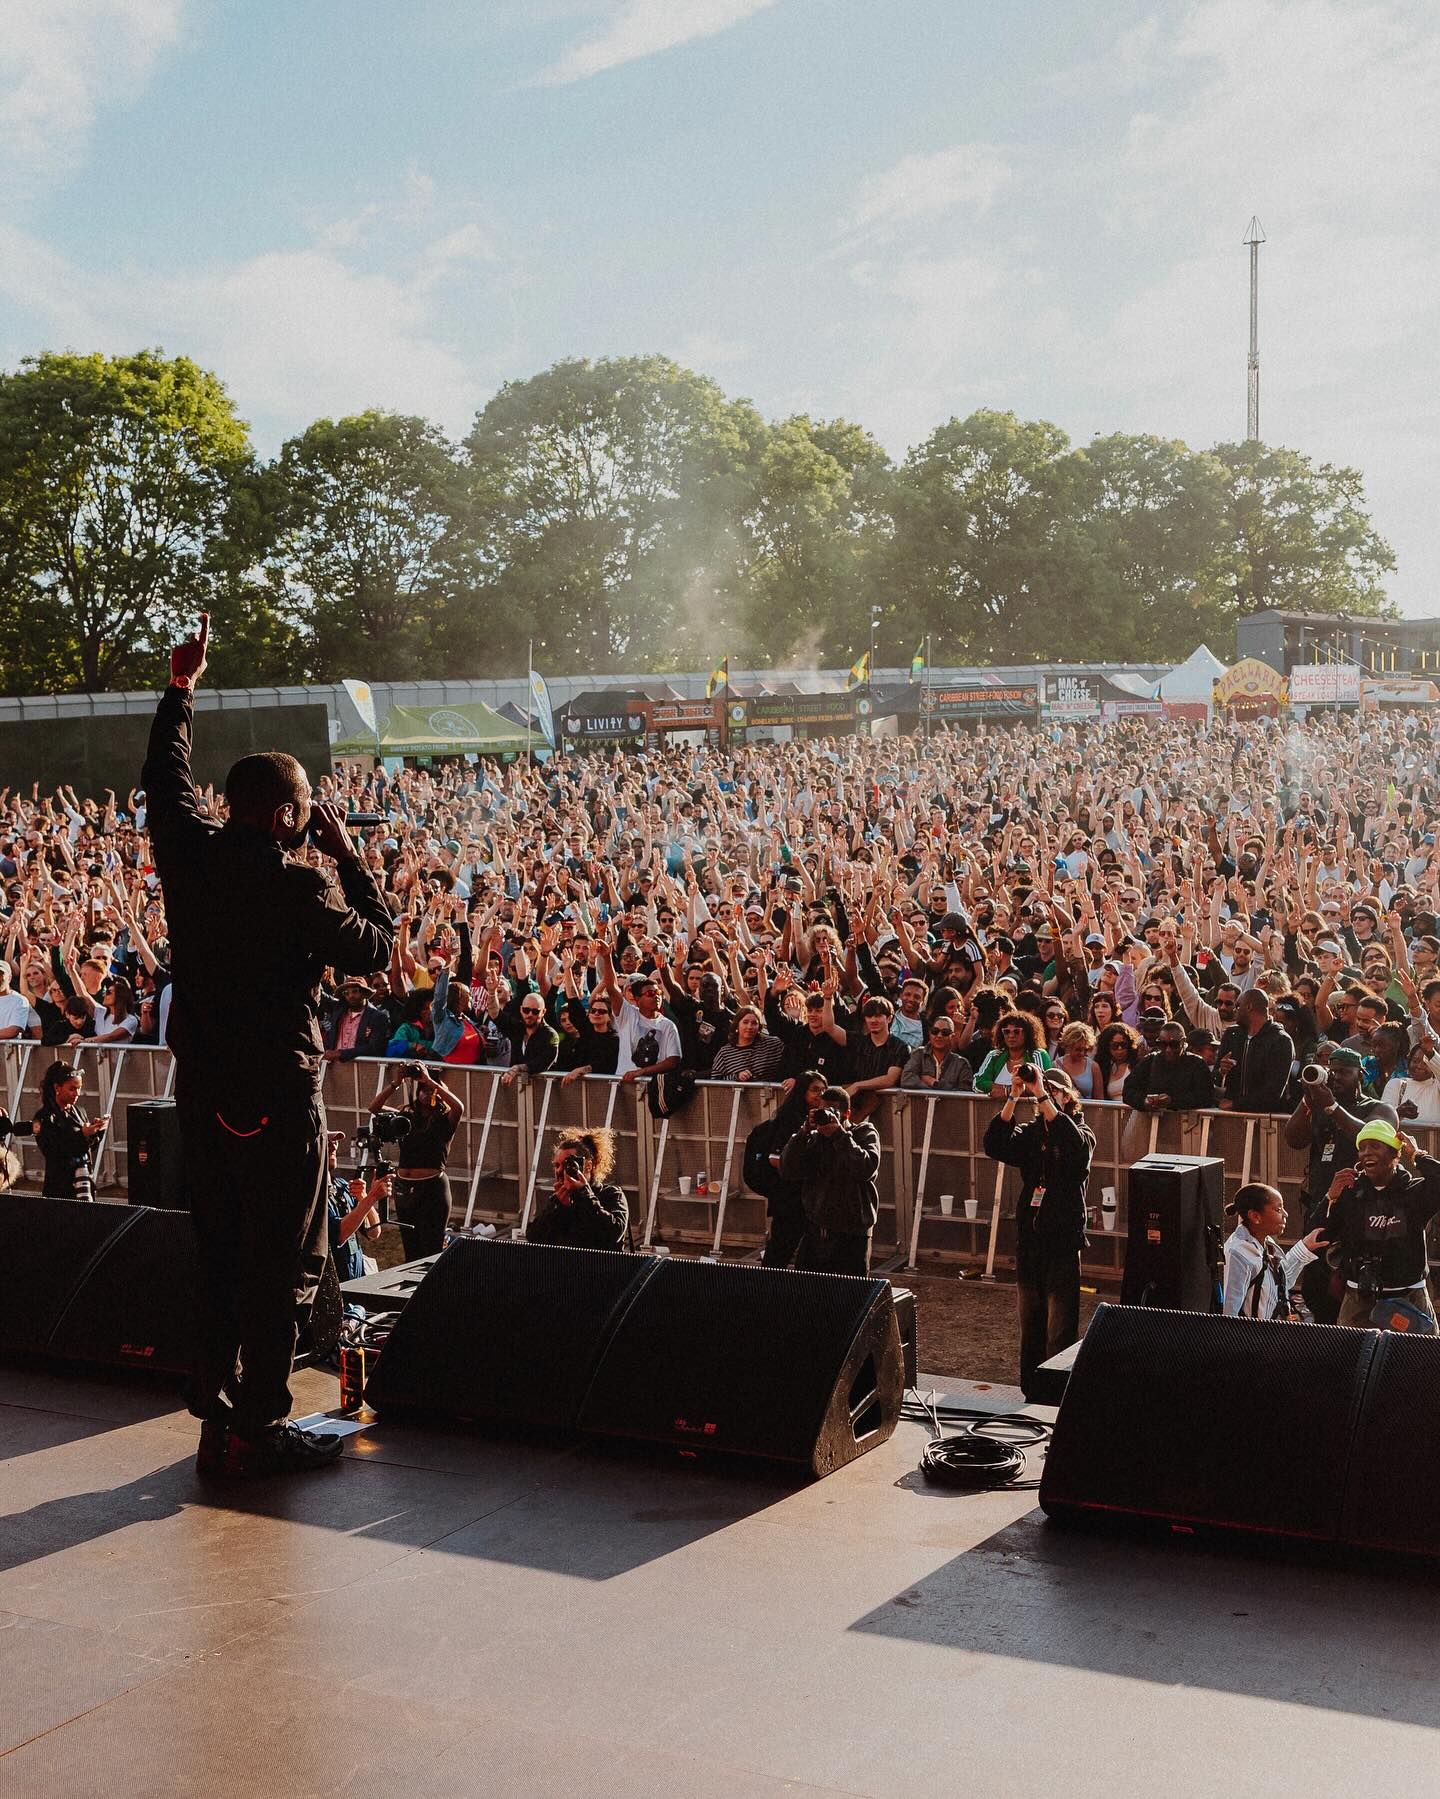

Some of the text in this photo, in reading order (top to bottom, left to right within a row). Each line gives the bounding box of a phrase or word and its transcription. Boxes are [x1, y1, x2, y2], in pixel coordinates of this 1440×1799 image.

[1058, 678, 1078, 689] MAC
[1293, 673, 1359, 686] CHEESESTEAK
[1058, 688, 1091, 702] CHEESE
[586, 717, 623, 731] LIVITY
